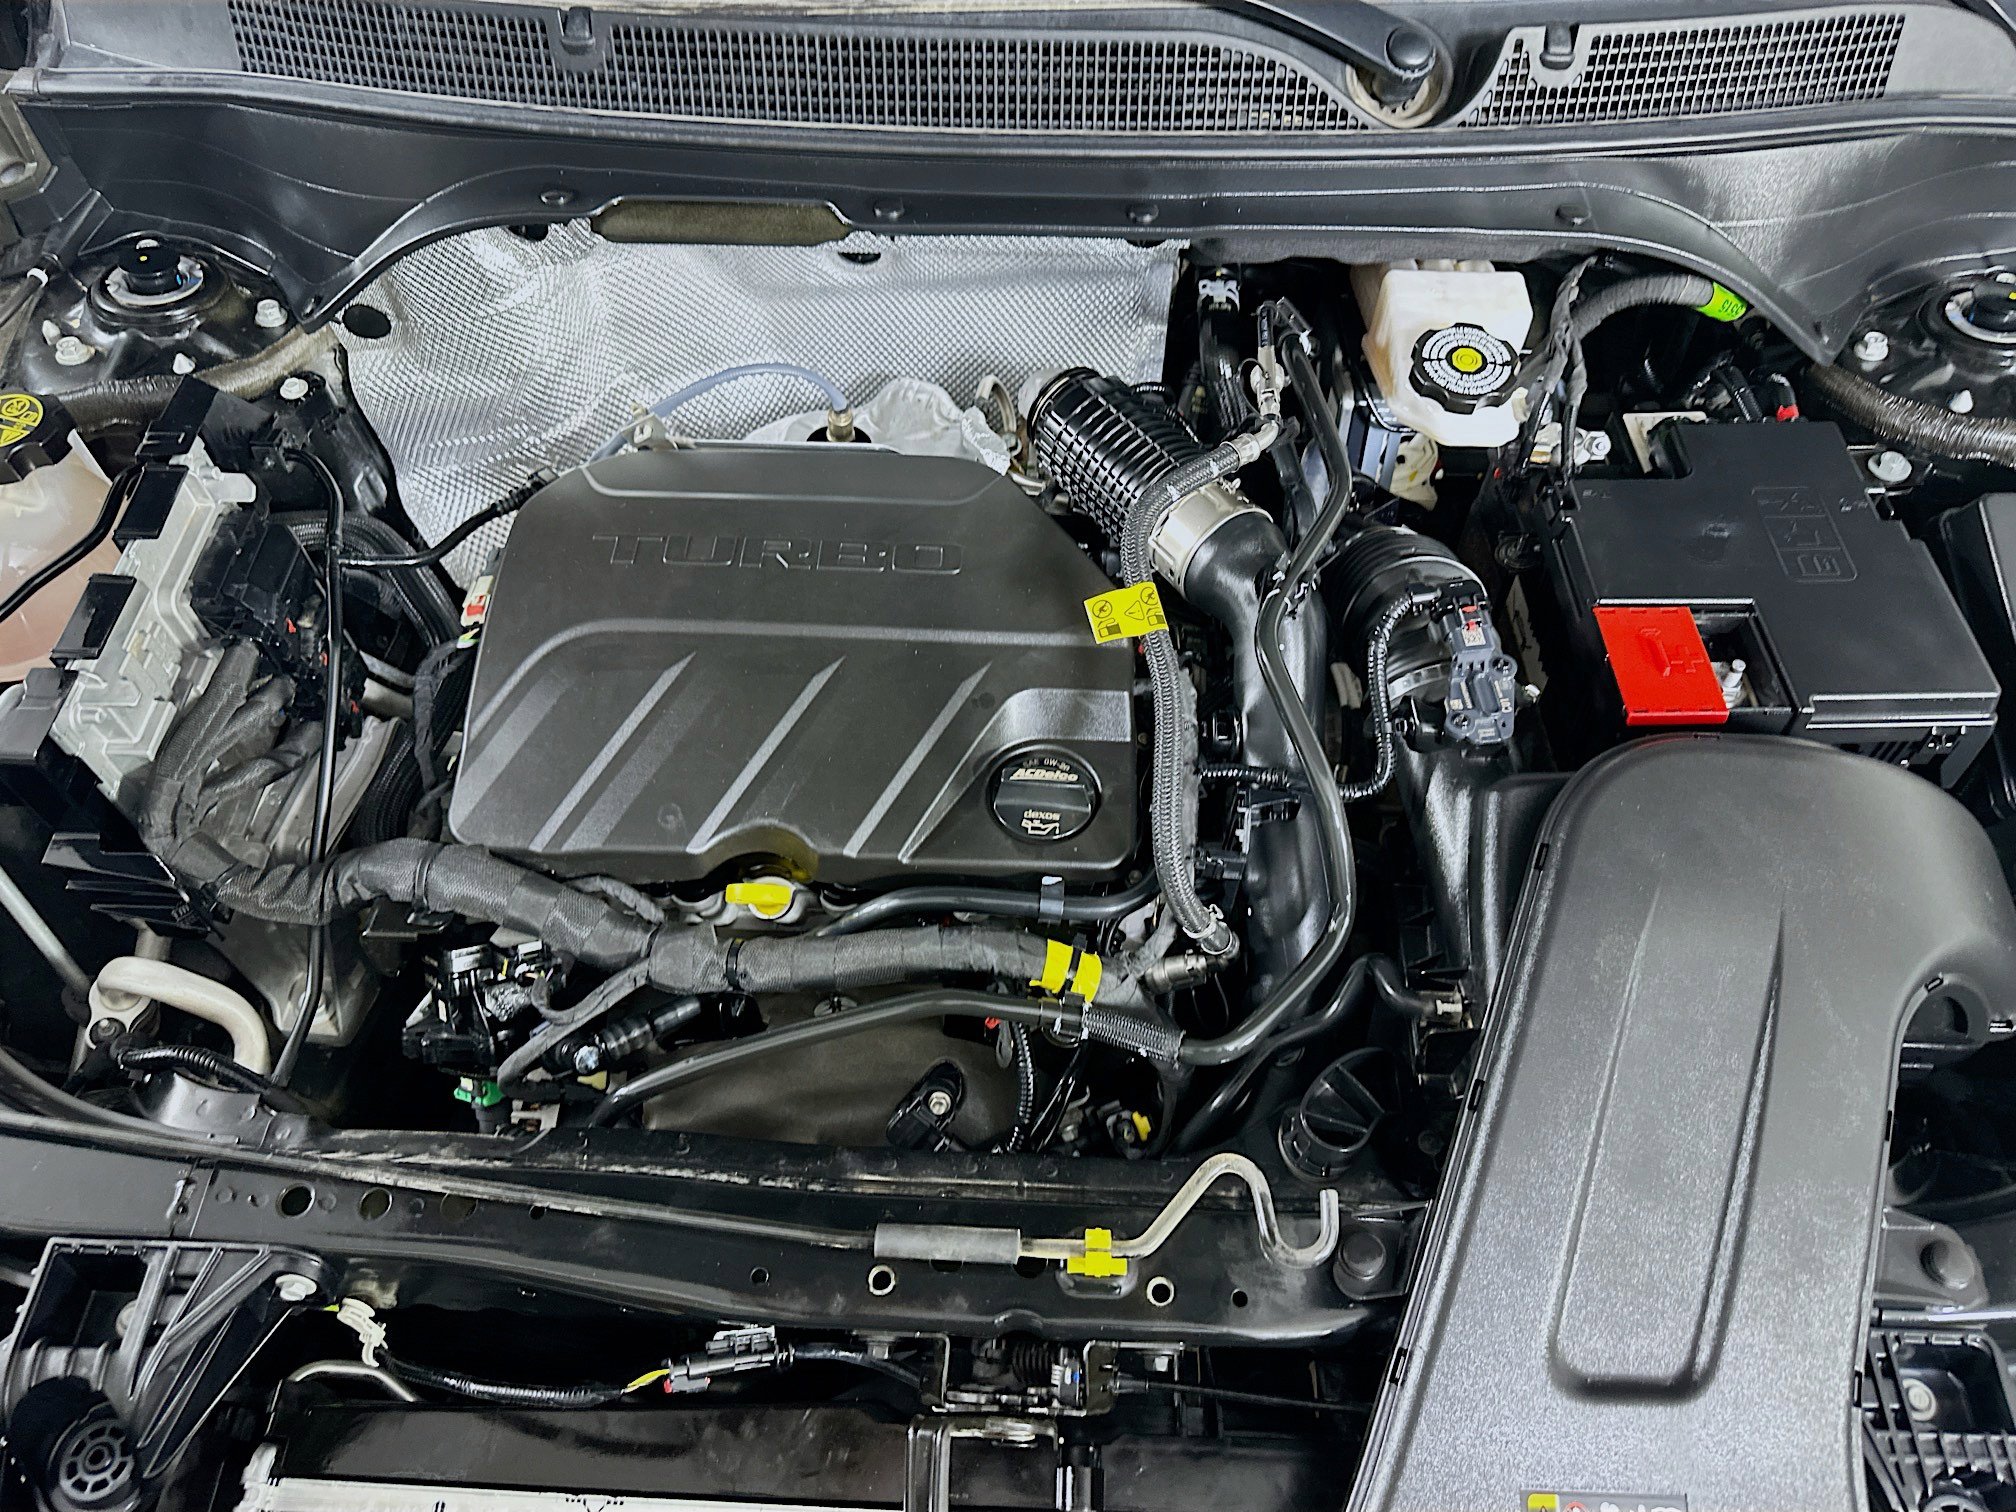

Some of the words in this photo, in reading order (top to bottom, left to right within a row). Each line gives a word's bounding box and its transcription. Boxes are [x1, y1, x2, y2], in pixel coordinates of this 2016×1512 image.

[592, 533, 965, 576] TURBO
[1009, 768, 1078, 781] ACDelco
[1023, 809, 1061, 821] dexos
